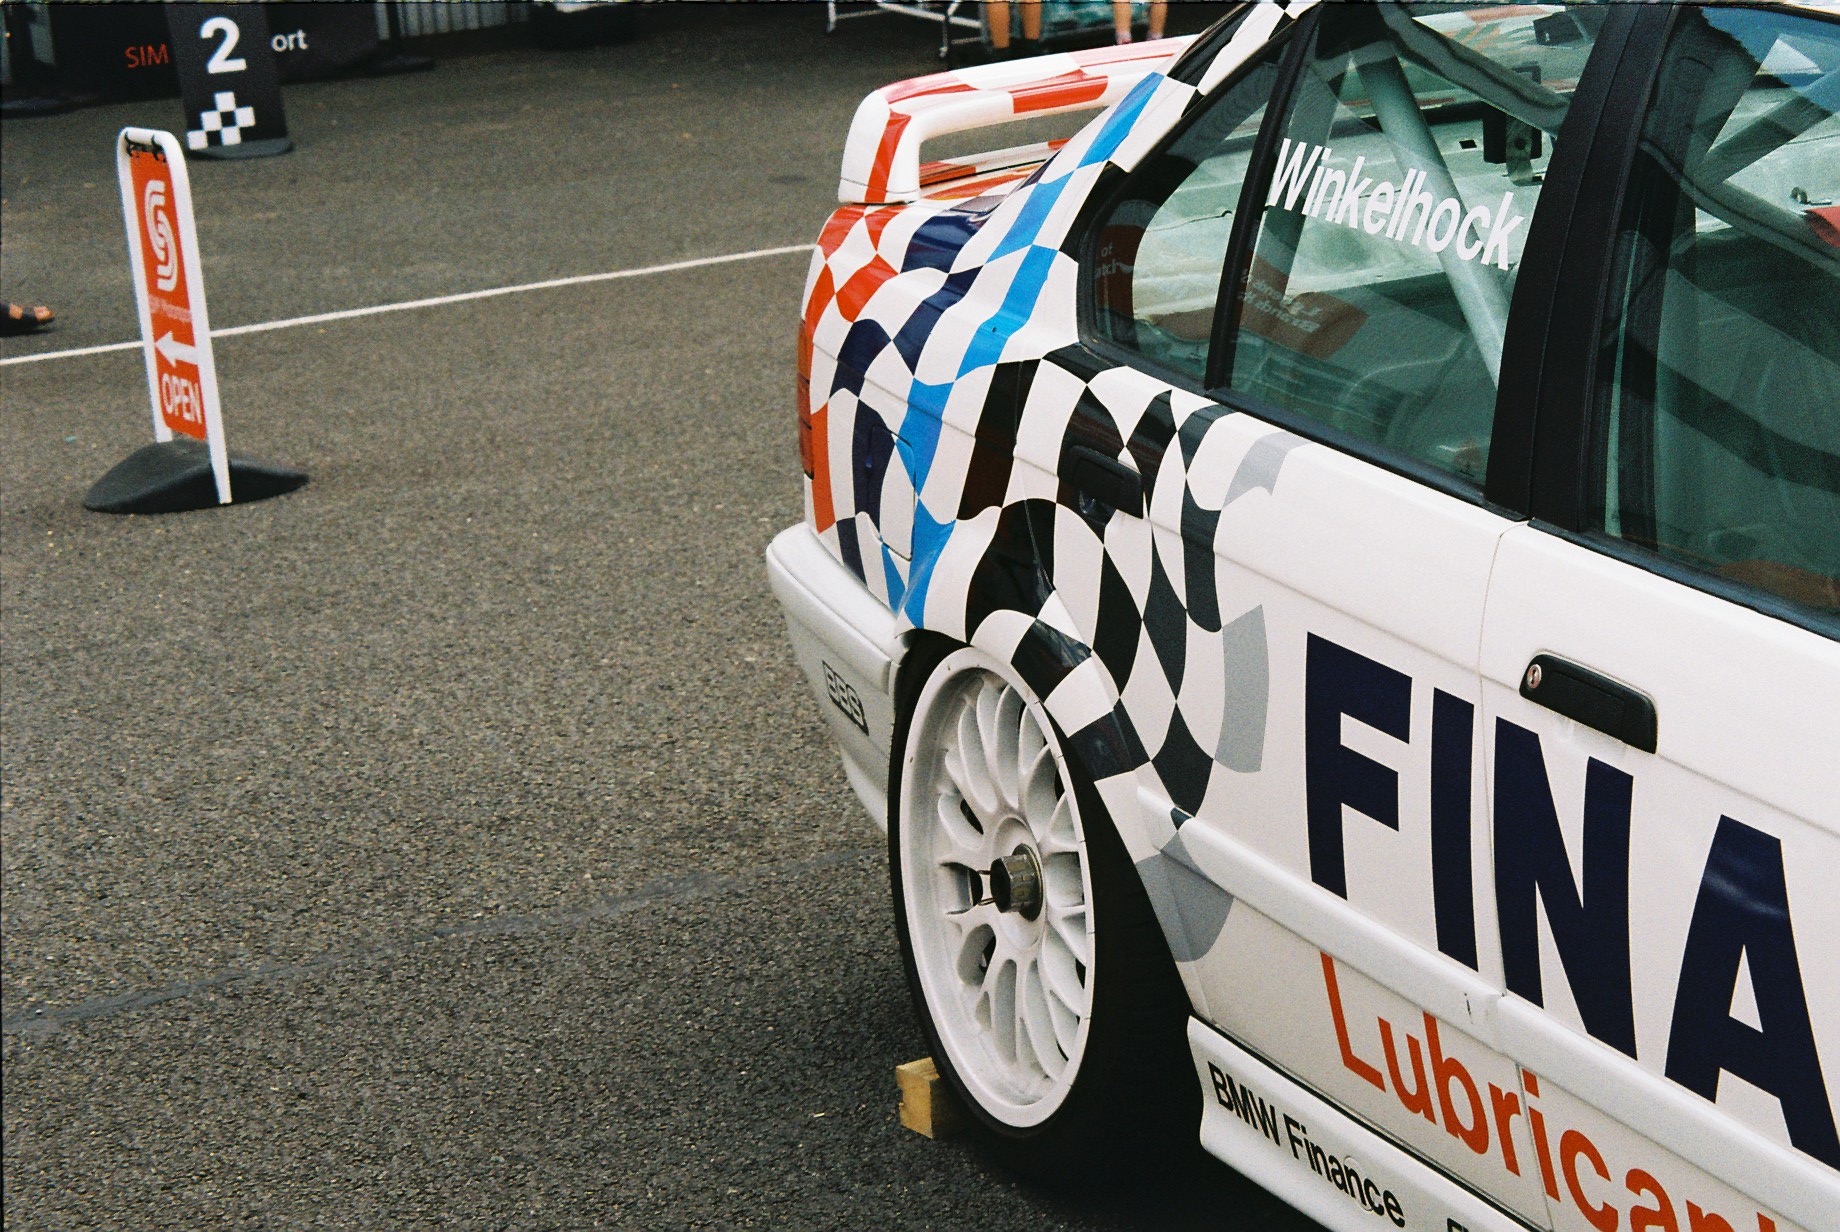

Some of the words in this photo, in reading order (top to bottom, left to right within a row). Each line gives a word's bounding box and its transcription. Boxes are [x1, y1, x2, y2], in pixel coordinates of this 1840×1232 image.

[200, 17, 247, 74] 2
[1264, 138, 1525, 271] Winkelhock
[161, 372, 203, 424] OPEN
[823, 660, 869, 736] BBS
[1304, 631, 1840, 1173] FINA
[1208, 1061, 1280, 1147] BMW
[1283, 1113, 1405, 1228] Finance
[1320, 951, 1778, 1232] Lubrica
